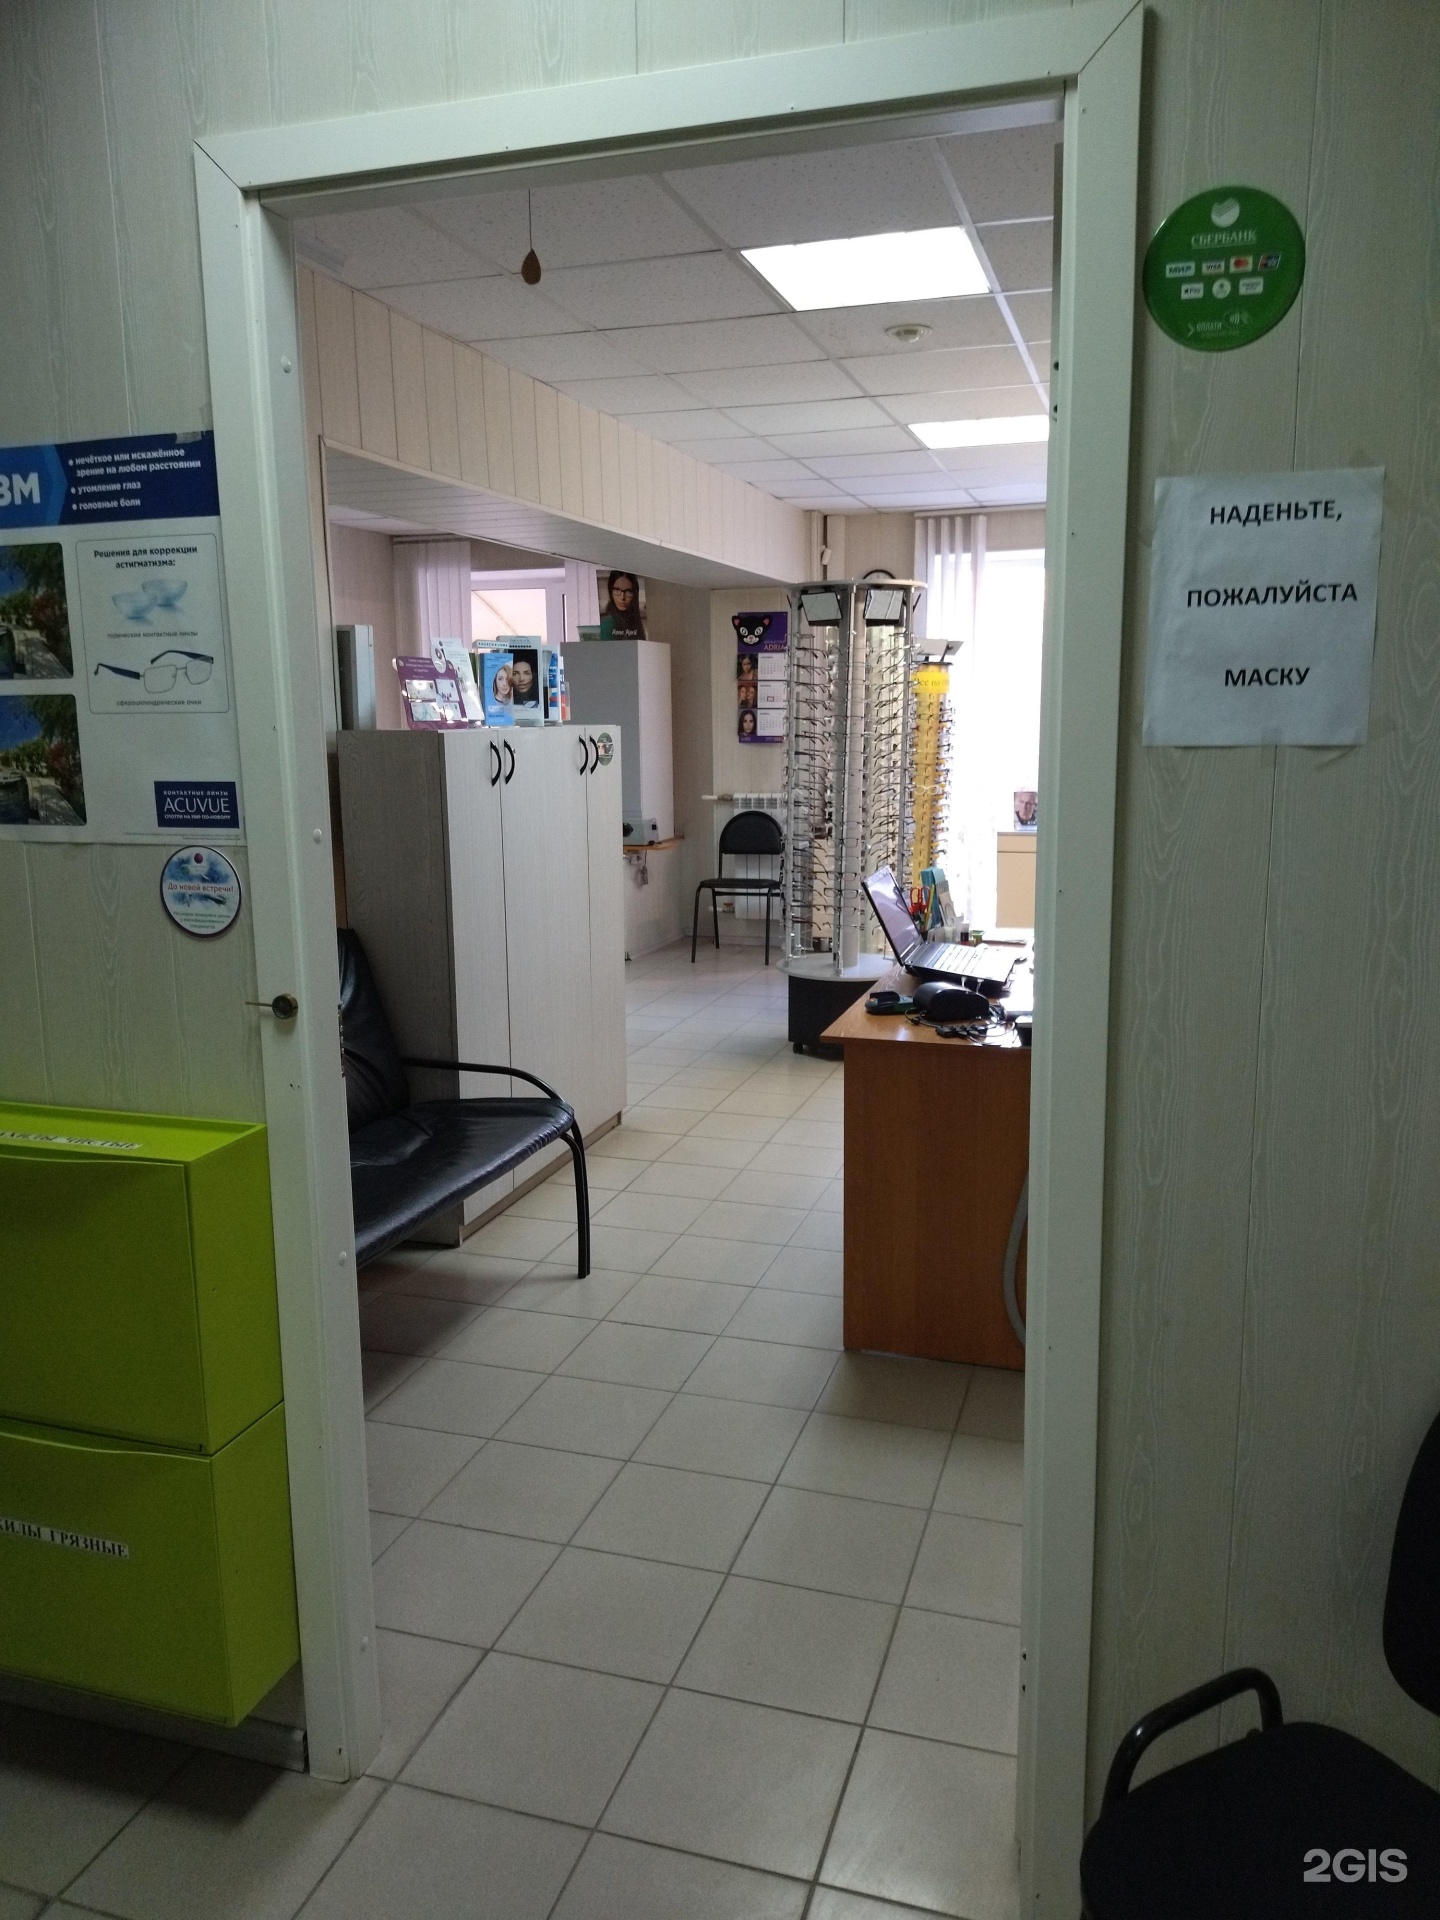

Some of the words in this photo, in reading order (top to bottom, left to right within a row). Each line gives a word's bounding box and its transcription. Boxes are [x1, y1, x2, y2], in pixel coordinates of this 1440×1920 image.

[1191, 230, 1257, 247] СБЕРБАНК
[1169, 266, 1191, 274] МИР
[75, 454, 112, 465] нечёткое
[114, 453, 130, 461] или
[131, 449, 185, 460] искажённое
[76, 467, 105, 478] зрение
[106, 466, 117, 474] на
[118, 463, 148, 473] любом
[149, 460, 201, 472] расстоянии
[77, 483, 121, 495] утомление
[122, 481, 142, 490] глаз
[79, 499, 119, 510] головные
[120, 498, 141, 508] боли
[1209, 499, 1343, 526] НАДЕНЬТЕ,
[93, 549, 131, 559] Решения
[132, 549, 147, 558] для
[149, 546, 198, 557] коррекции
[115, 559, 176, 569] астигматизма:
[1186, 579, 1358, 608] ПОЖАЛУЙСТА
[1223, 666, 1310, 687] МАСКУ
[163, 797, 231, 813] ACUVUE
[167, 882, 178, 891] До
[202, 885, 234, 894] встречи!
[50, 1529, 128, 1558] ГРЯЗНЫЕ
